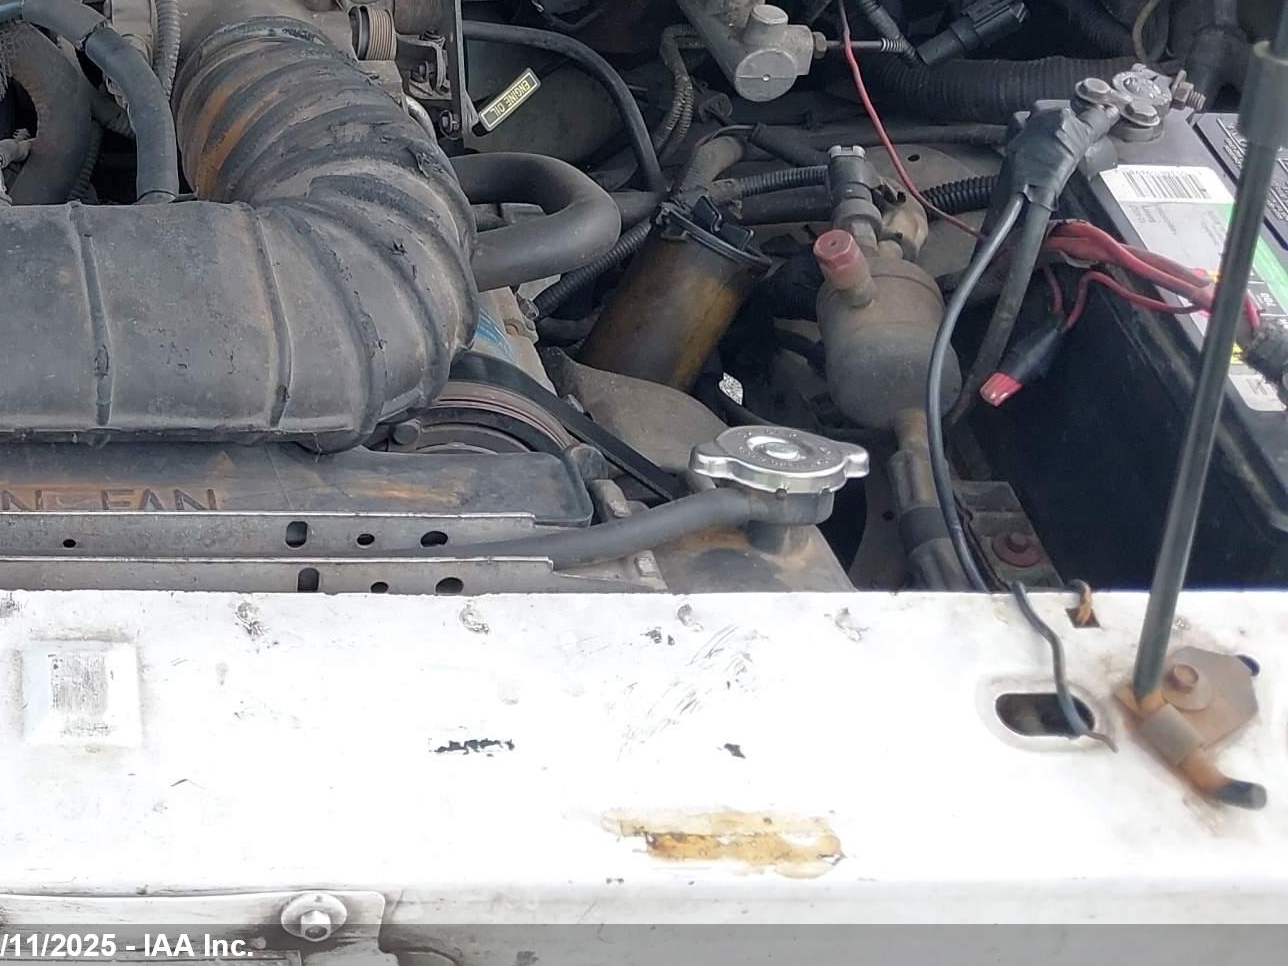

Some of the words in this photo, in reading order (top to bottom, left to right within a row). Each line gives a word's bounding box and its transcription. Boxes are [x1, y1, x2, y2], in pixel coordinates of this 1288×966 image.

[504, 80, 530, 106] ENGINE
[490, 104, 505, 117] OIL
[100, 489, 218, 512] FAN
